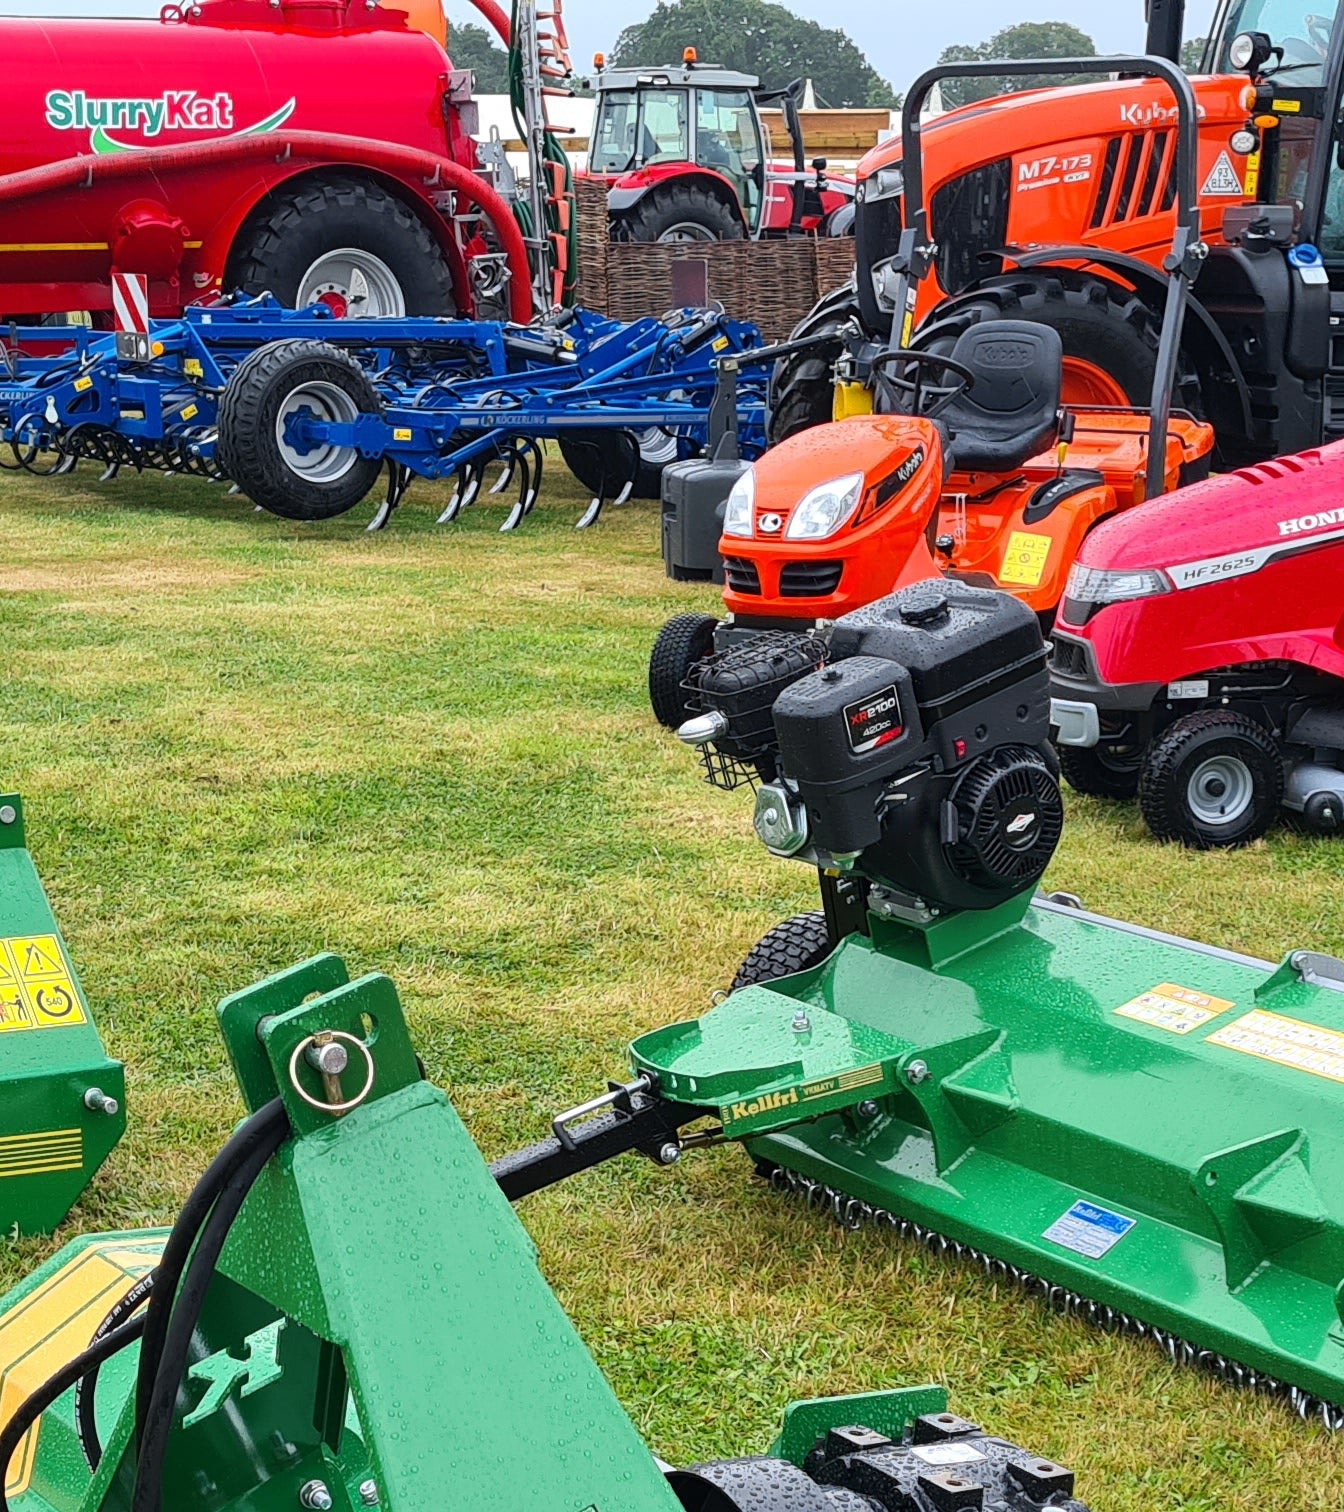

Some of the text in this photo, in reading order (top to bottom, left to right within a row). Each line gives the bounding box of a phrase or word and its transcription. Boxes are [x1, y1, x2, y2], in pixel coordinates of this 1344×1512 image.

[46, 90, 233, 136] SlurryKat
[1119, 102, 1206, 125] Kuboa
[1018, 153, 1093, 182] M7-173
[896, 450, 924, 481] Kubota
[1183, 556, 1255, 580] HF 2625
[850, 697, 896, 725] XR2100
[863, 720, 892, 737] 420cc
[45, 996, 63, 1006] 540
[731, 1087, 799, 1120] Kellfri
